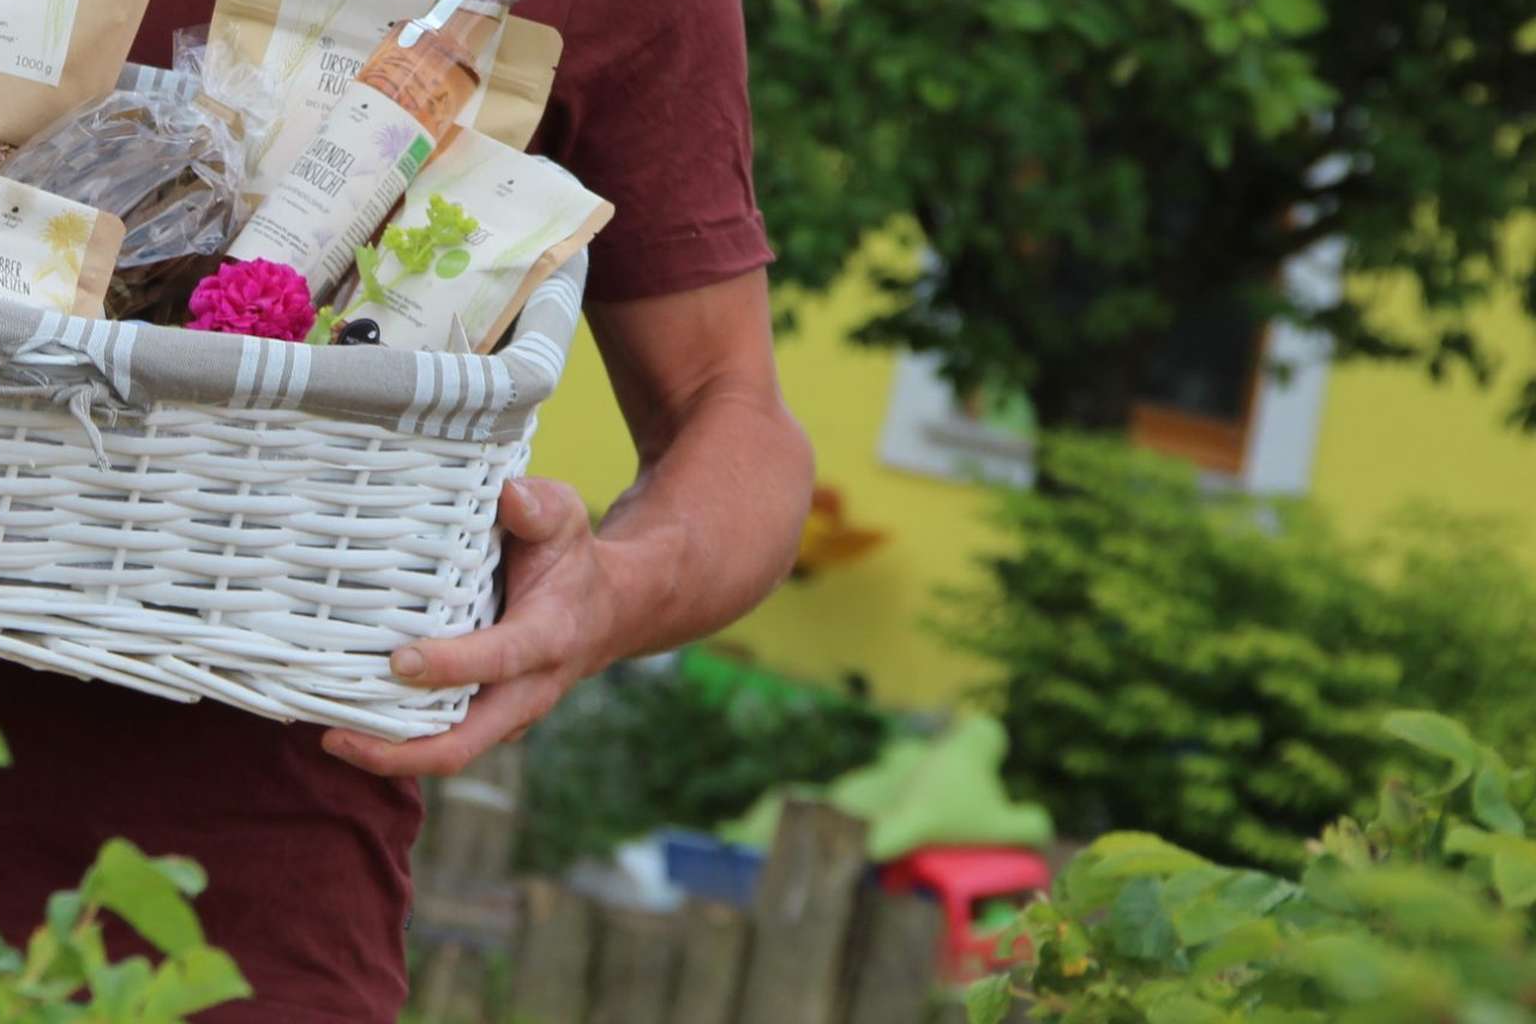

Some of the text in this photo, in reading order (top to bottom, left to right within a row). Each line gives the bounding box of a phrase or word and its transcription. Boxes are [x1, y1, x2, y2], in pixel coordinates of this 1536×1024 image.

[15, 55, 53, 75] 1000 g
[320, 51, 365, 77] URSPR
